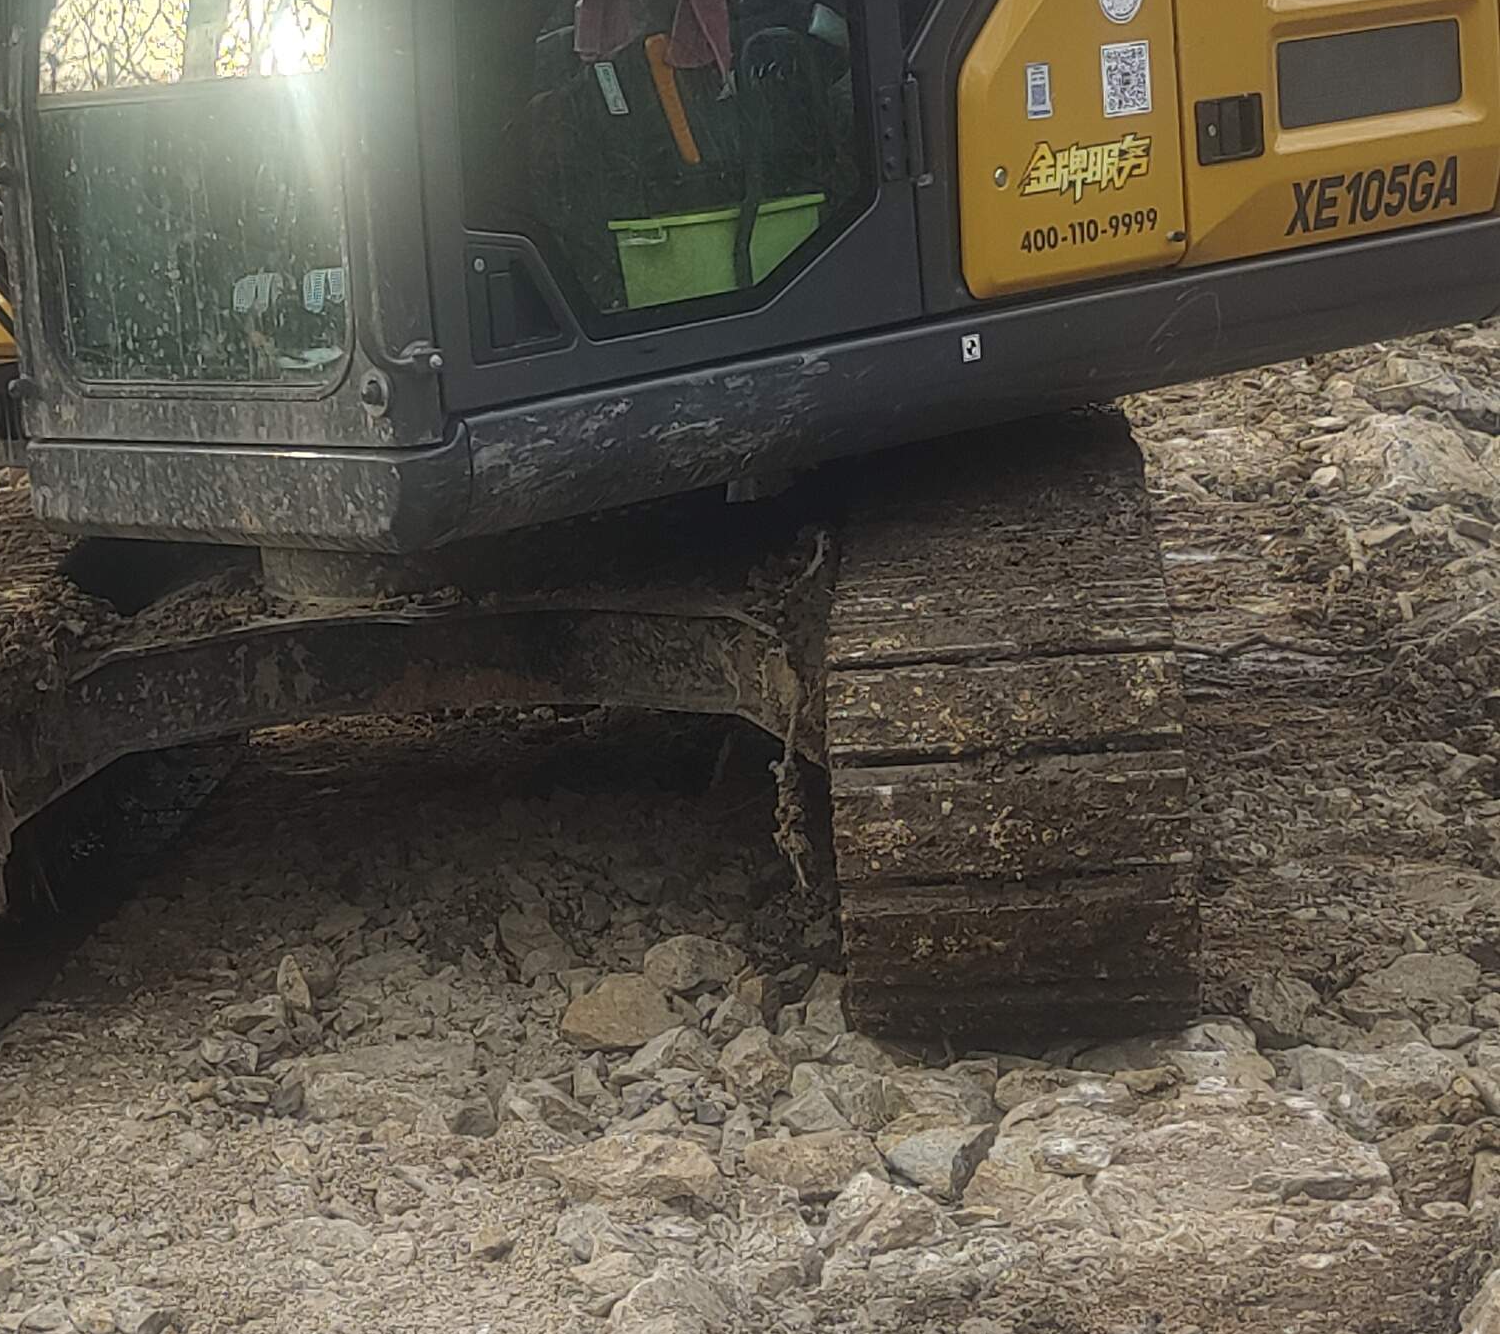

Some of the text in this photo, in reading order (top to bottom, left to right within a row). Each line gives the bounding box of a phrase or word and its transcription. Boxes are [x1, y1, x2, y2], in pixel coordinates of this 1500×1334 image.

[1019, 133, 1152, 204] 金牌服务
[1284, 156, 1458, 236] XE105GA
[1021, 208, 1158, 253] 400-110-9999
